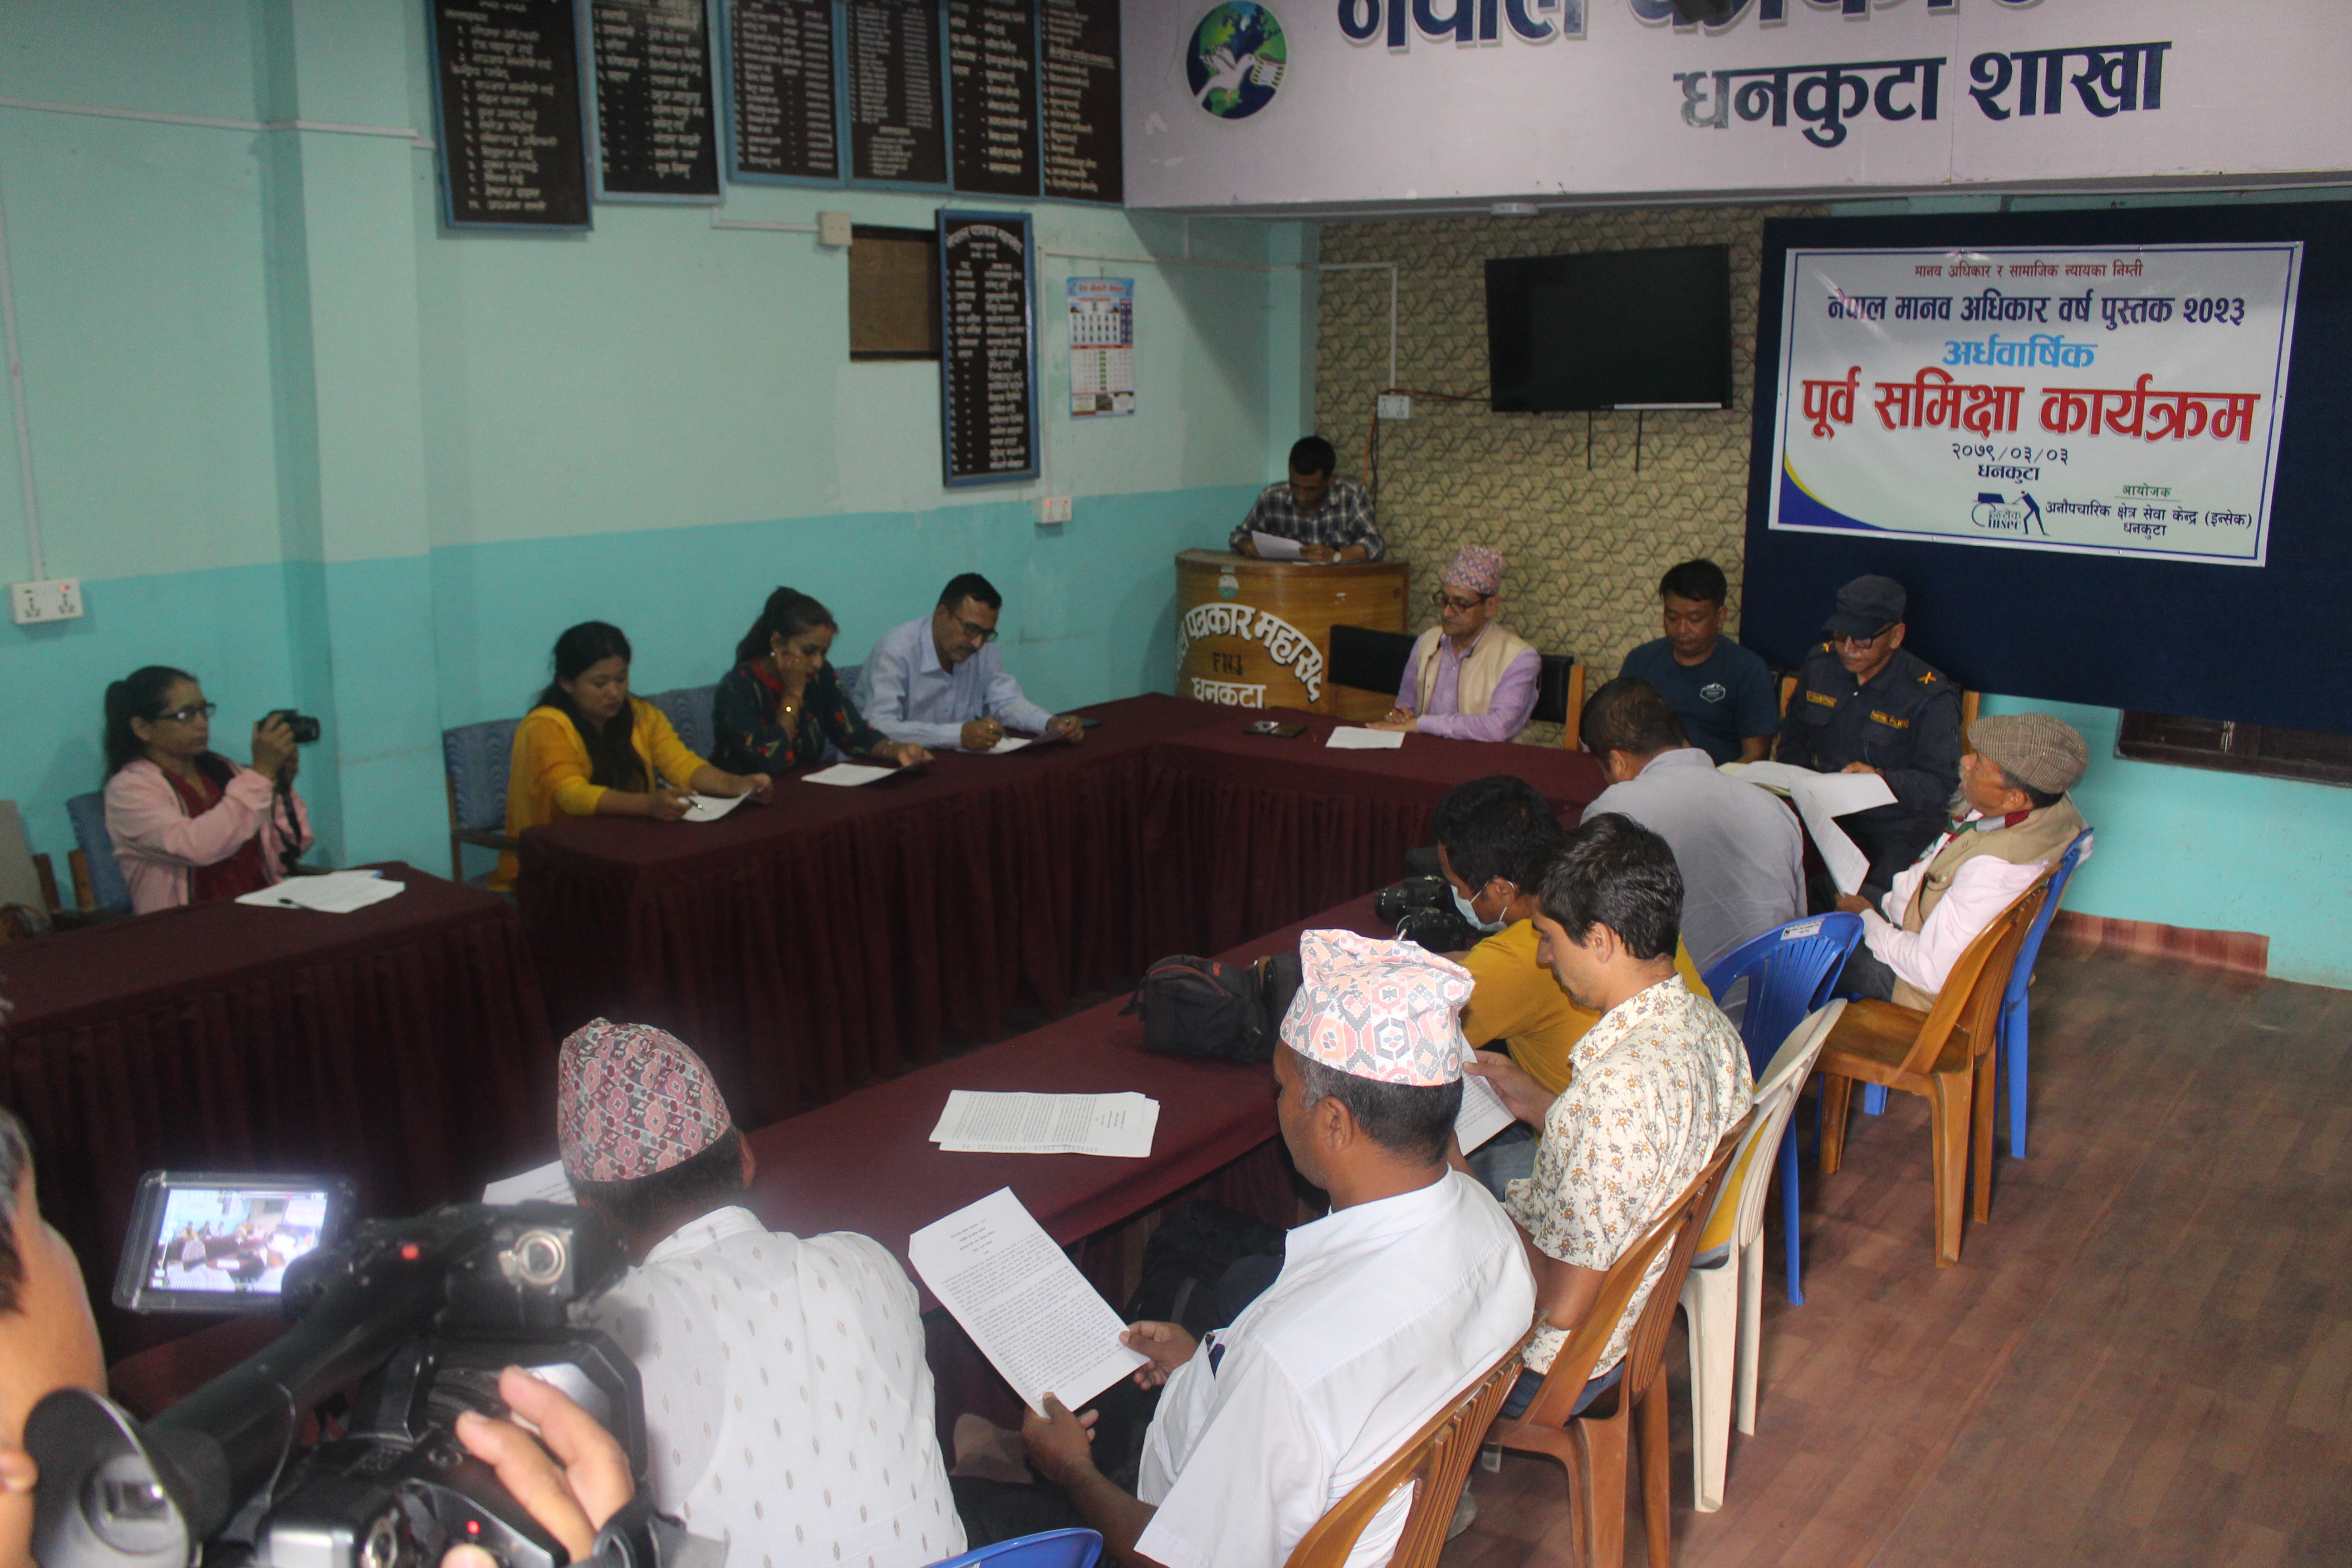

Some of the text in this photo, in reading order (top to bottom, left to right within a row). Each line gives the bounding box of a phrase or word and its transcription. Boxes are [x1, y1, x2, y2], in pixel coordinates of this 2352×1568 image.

[1673, 41, 2173, 148] धनकुटा शाखा
[1915, 265, 1943, 278] मानव
[1948, 260, 1992, 279] अधिकार
[1996, 265, 2005, 279] र
[2009, 260, 2060, 279] सामाजिक
[2065, 265, 2107, 278] न्यायका
[1895, 297, 1953, 321] मानव
[1960, 288, 2051, 323] अधिकार
[2058, 288, 2094, 322] वर्ष
[2101, 297, 2176, 331] पुस्तक
[2183, 297, 2245, 326] २०२३
[1942, 333, 2099, 368] अर्धवार्षिक
[1801, 366, 2262, 442] पूर्व समिक्षा कार्यक्रम
[1977, 464, 2041, 485] धनकुटा
[2122, 483, 2172, 497] आयोजक
[2143, 504, 2167, 521] सेवा
[2172, 506, 2199, 526] केन्द्र
[2123, 522, 2168, 540] धनकुटा
